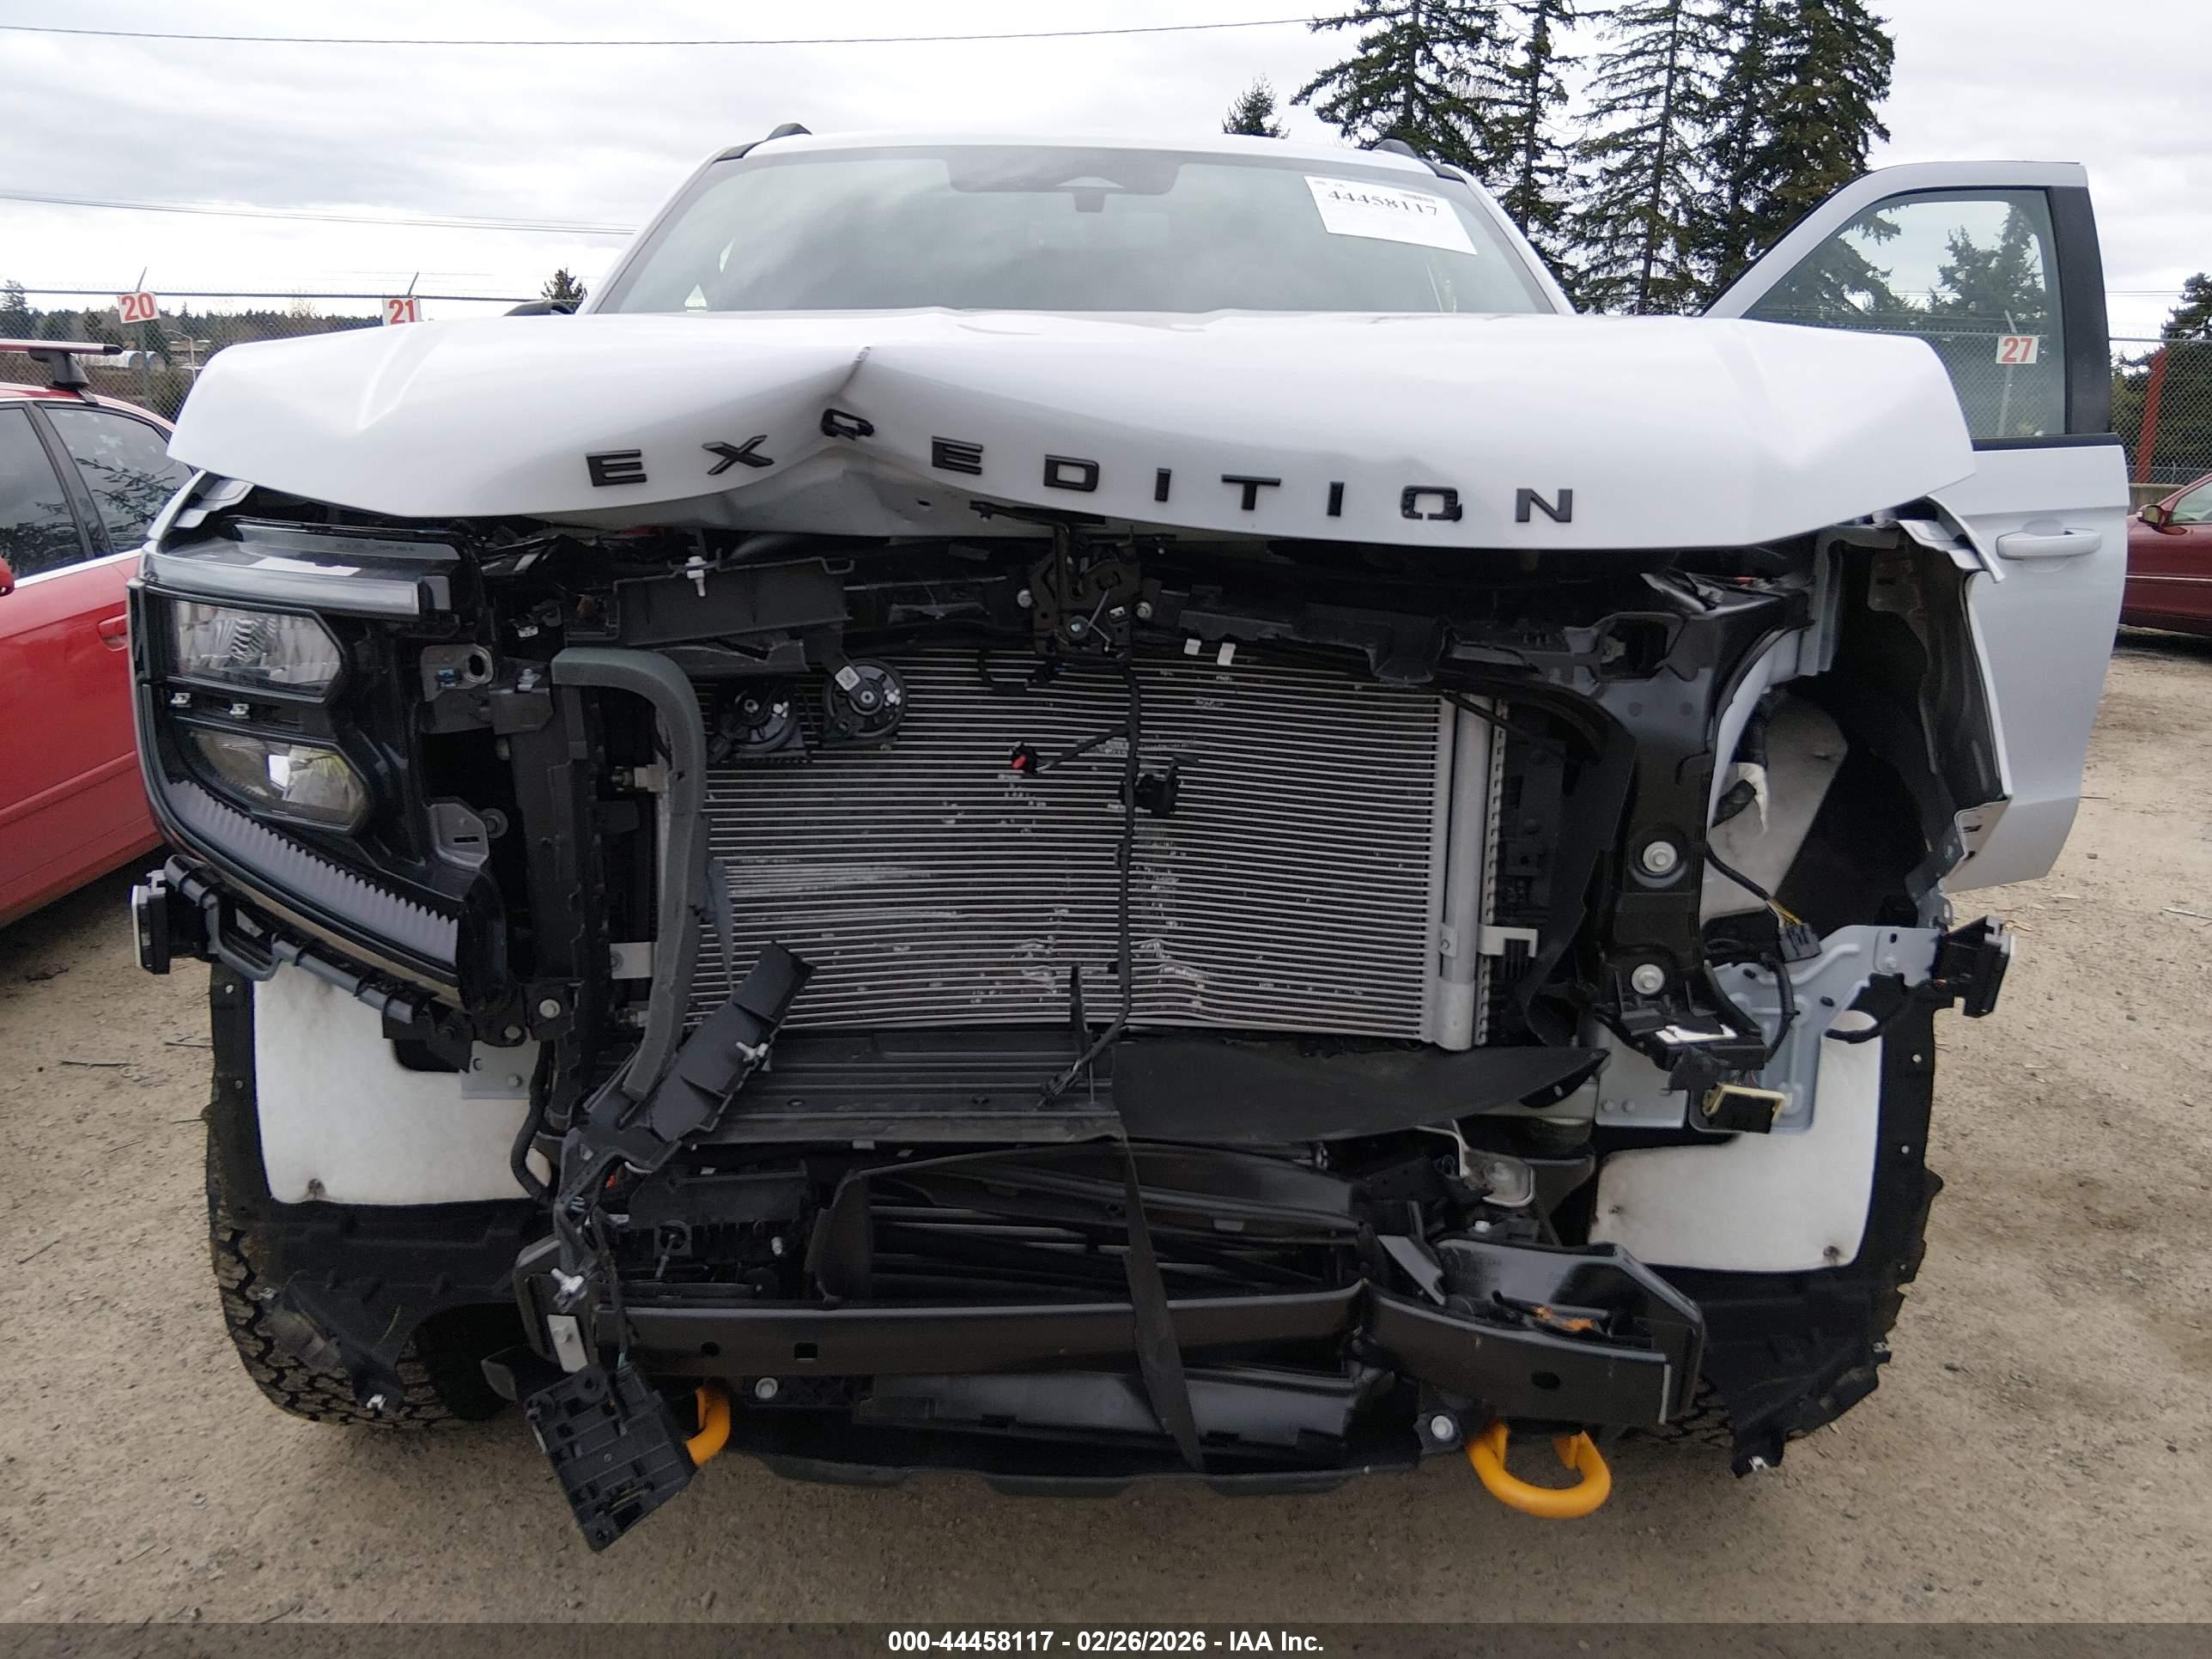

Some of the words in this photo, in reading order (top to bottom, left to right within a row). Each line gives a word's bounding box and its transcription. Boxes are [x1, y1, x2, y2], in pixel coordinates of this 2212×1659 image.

[1328, 189, 1438, 216] 44458117
[121, 293, 155, 321] 20
[388, 299, 416, 325] 21
[2001, 337, 2034, 363] 27
